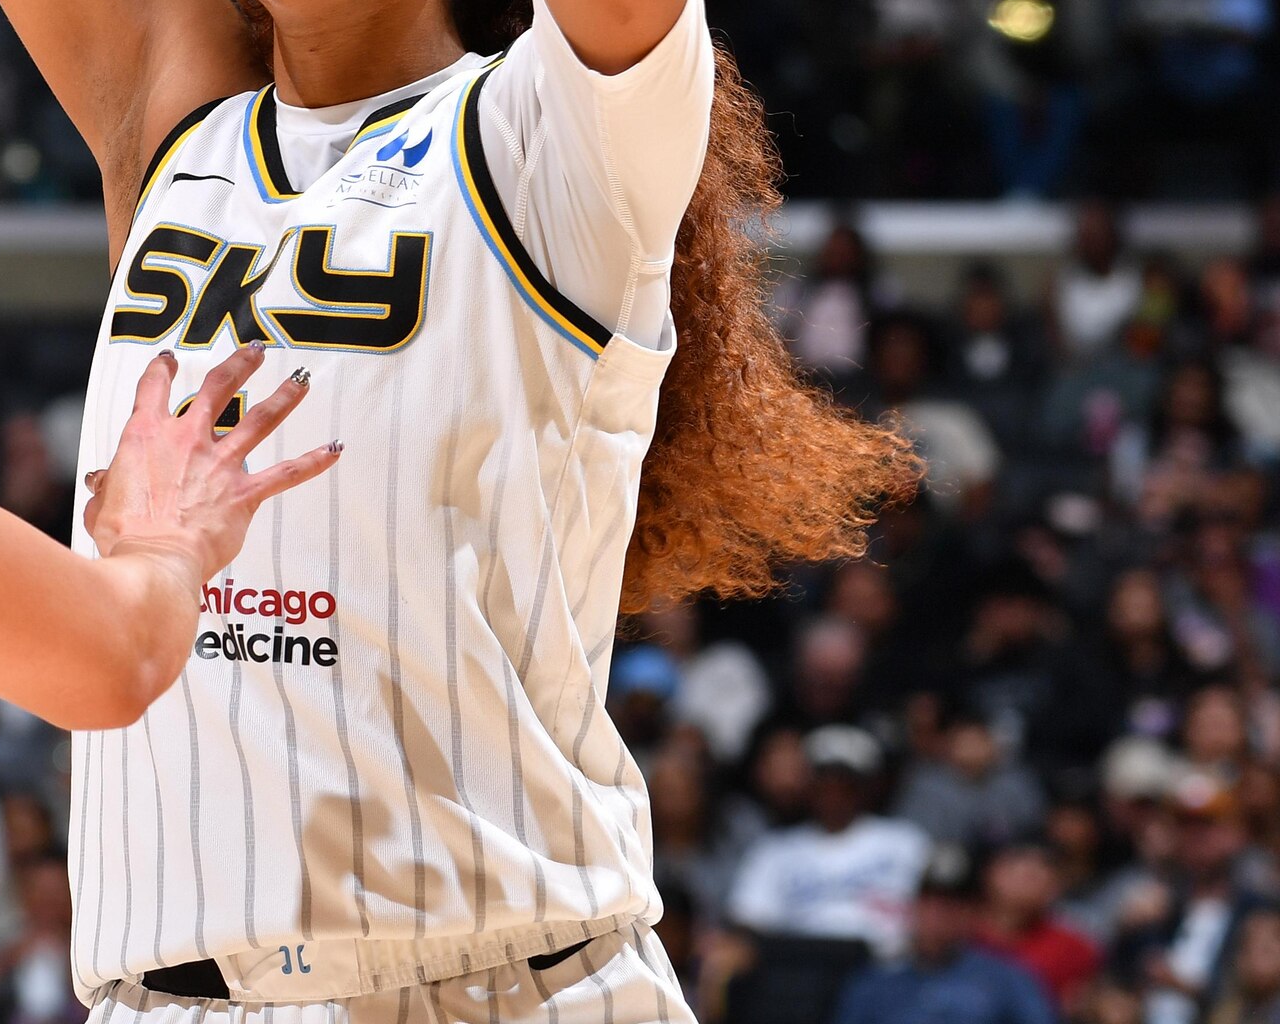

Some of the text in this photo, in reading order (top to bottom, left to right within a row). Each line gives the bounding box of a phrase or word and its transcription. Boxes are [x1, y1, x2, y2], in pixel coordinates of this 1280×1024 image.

[109, 222, 434, 355] SKY
[200, 578, 337, 625] hicago
[194, 623, 339, 667] edicine
